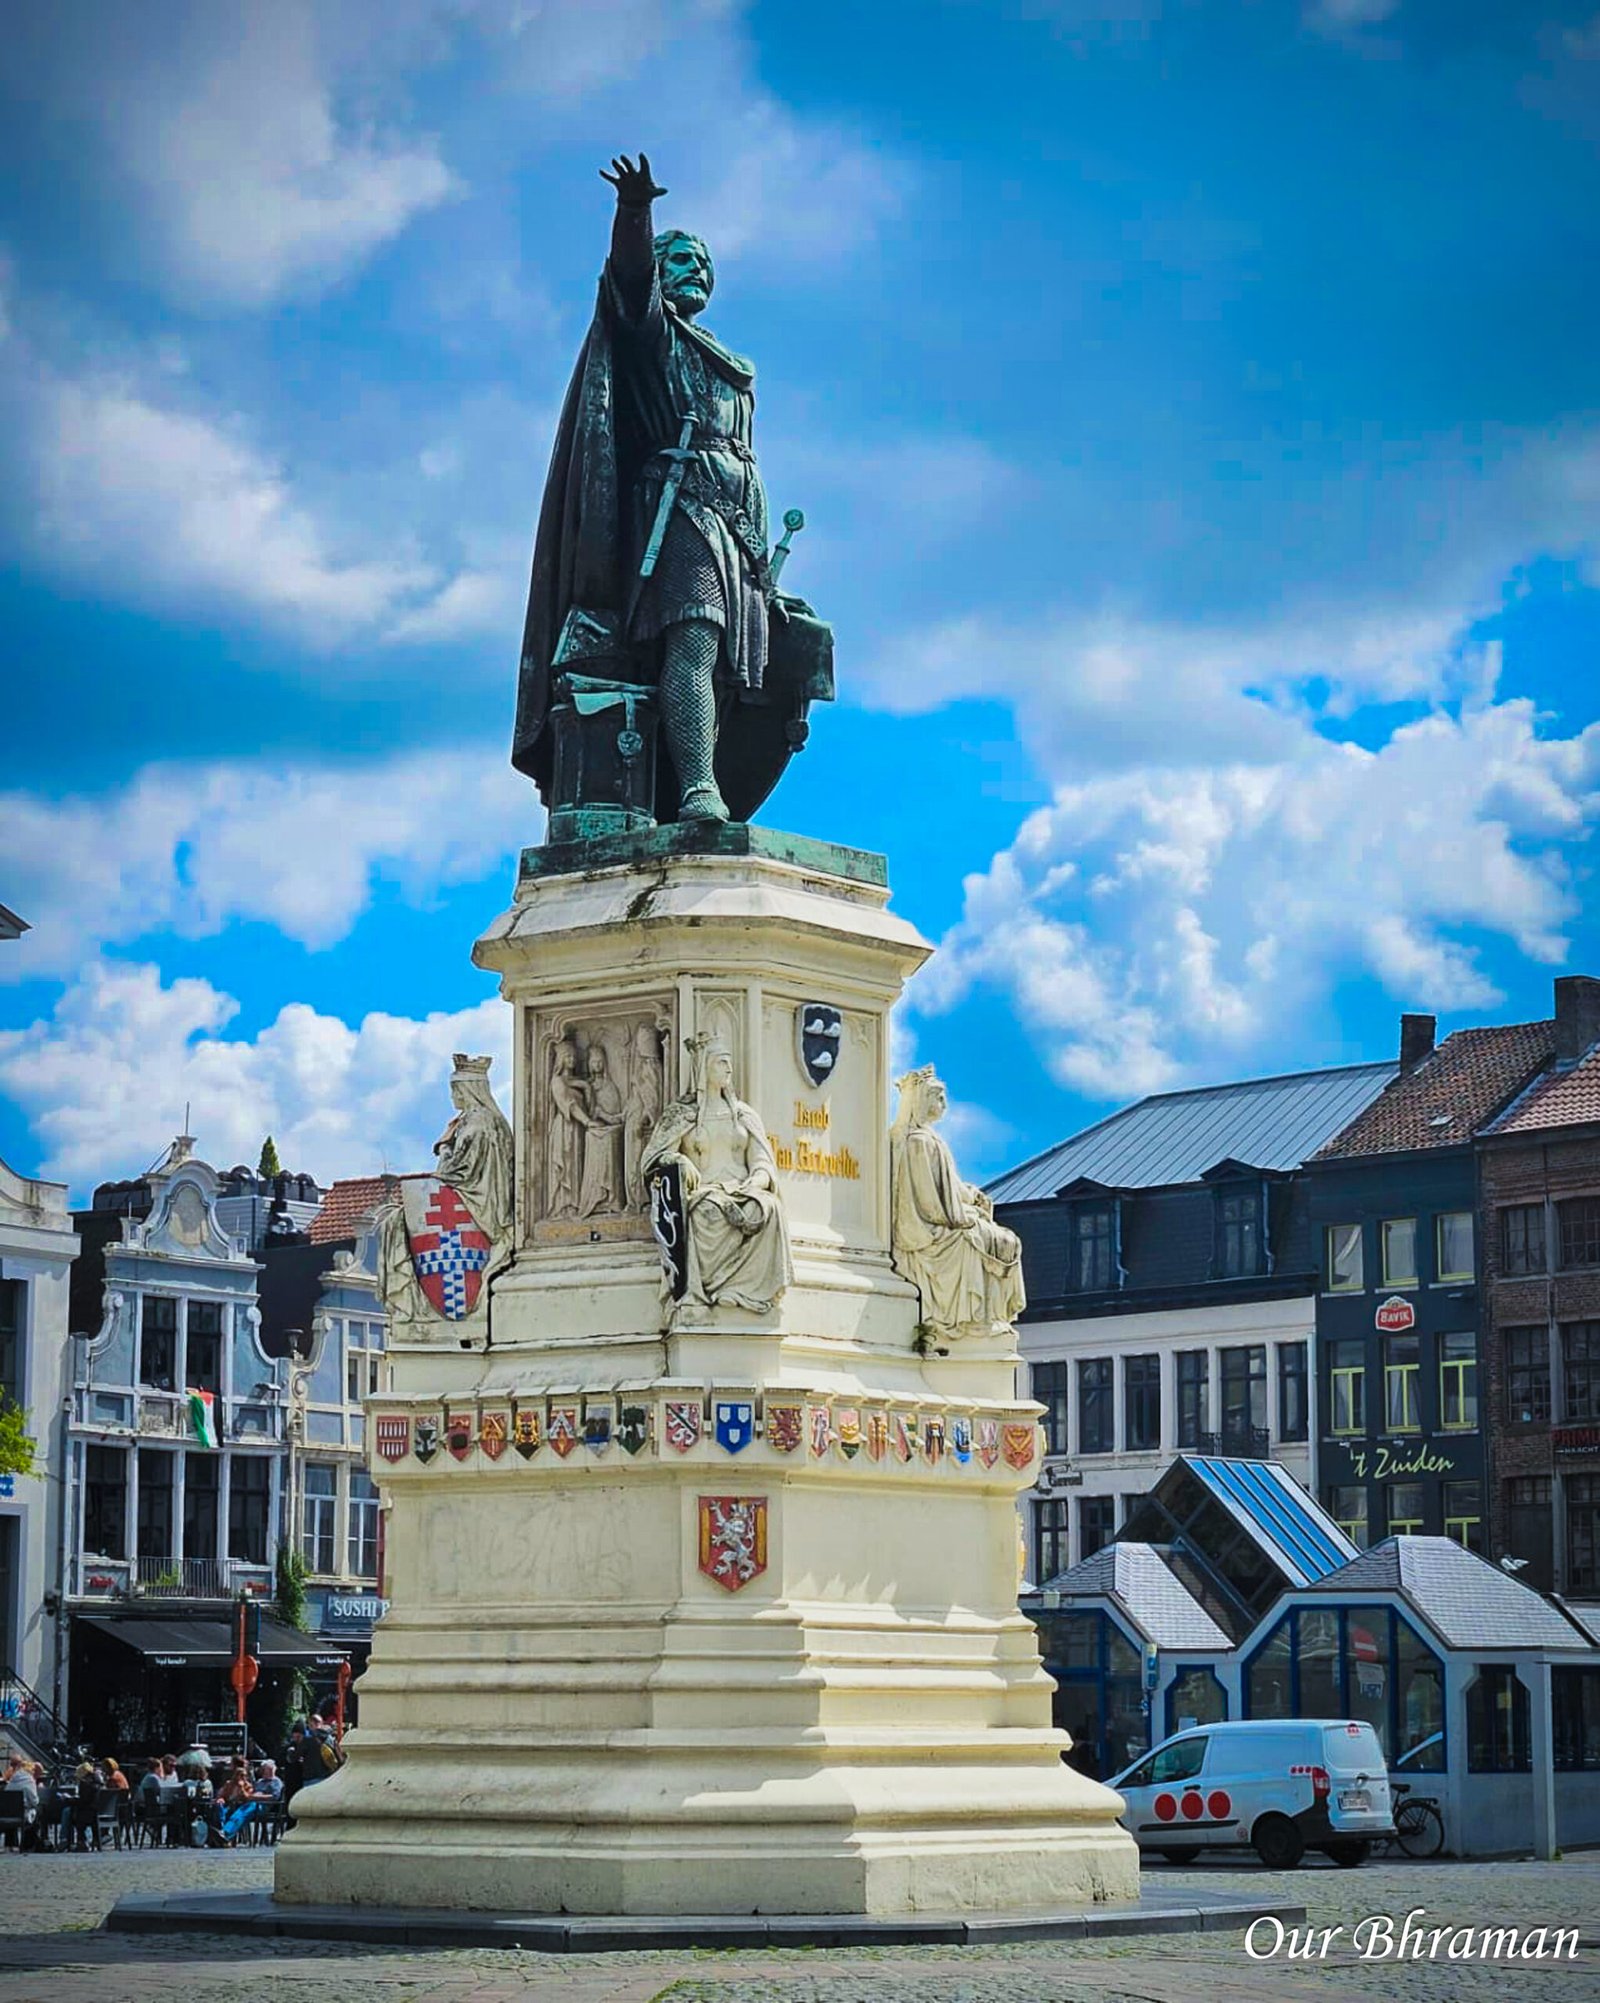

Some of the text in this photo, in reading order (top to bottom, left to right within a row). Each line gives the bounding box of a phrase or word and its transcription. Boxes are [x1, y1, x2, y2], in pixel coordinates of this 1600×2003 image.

[1380, 1310, 1410, 1323] BAVIK
[1374, 1443, 1455, 1479] Zuiden
[333, 1600, 377, 1617] SUSHI
